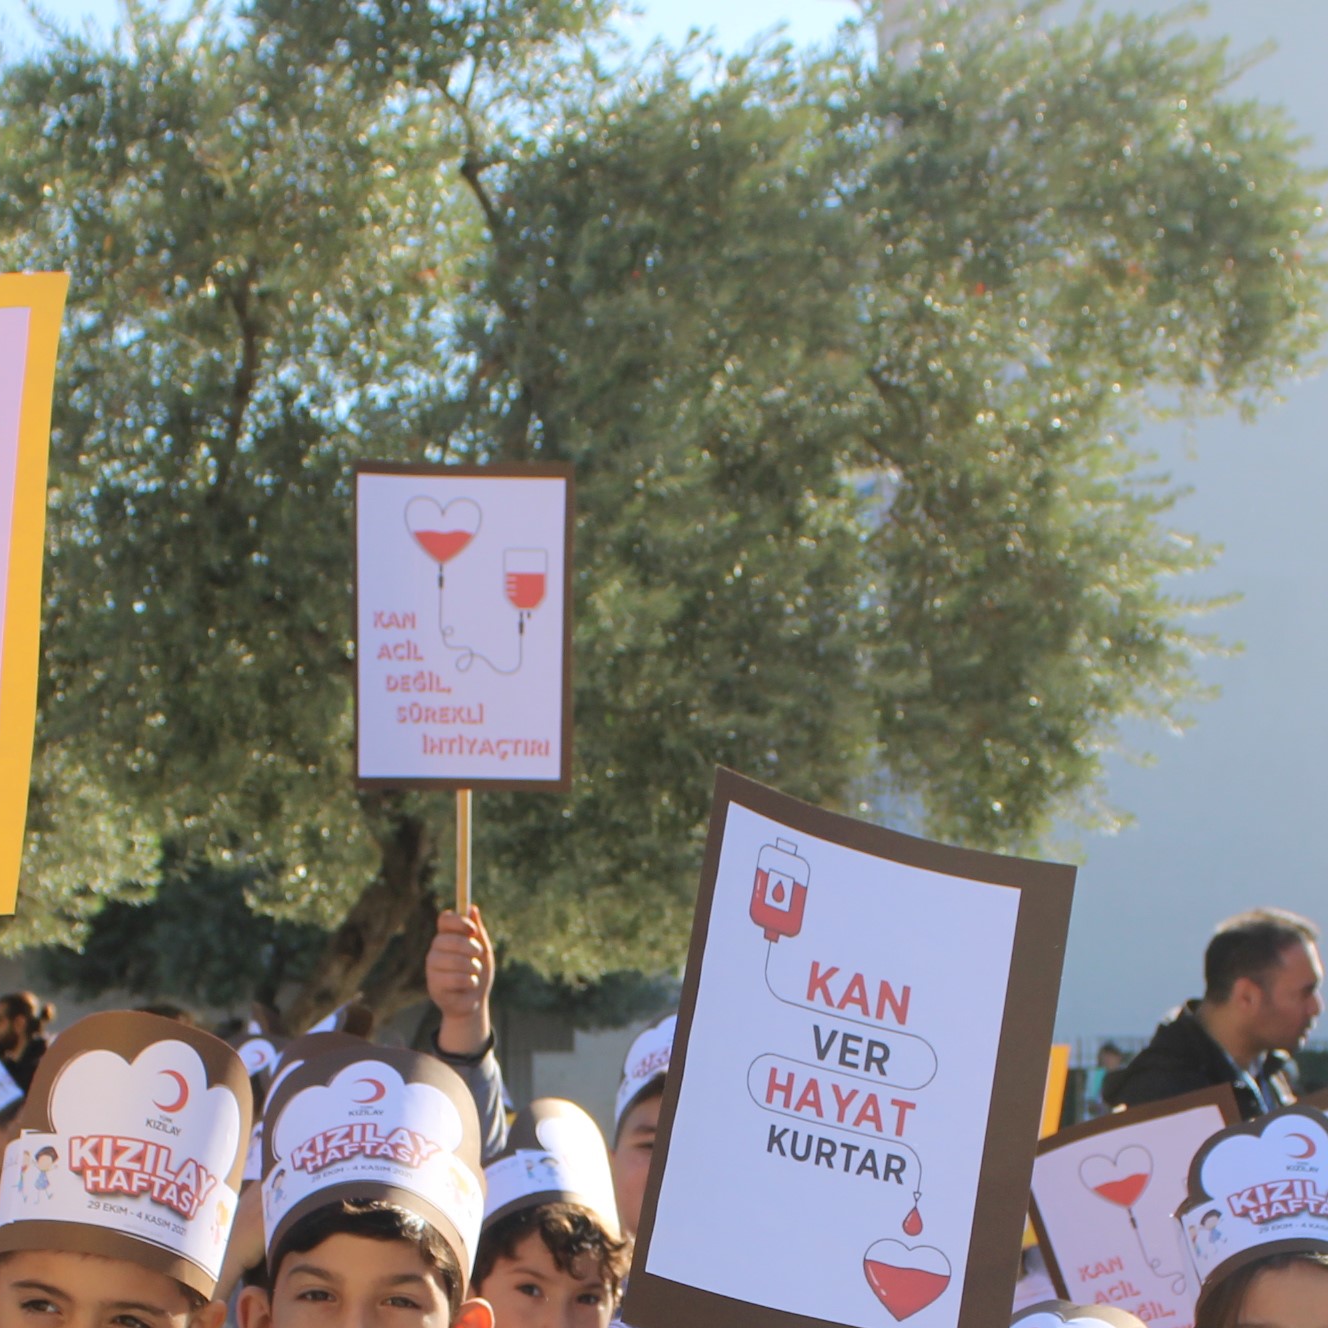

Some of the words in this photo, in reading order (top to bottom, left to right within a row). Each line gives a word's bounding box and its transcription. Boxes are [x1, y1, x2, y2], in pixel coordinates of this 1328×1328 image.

[373, 610, 416, 630] KAN
[377, 639, 424, 661] ACİL
[396, 703, 484, 725] SÜREKLİ
[806, 961, 911, 1026] KAN
[812, 1024, 891, 1077] VER
[764, 1067, 916, 1138] HAYAT
[145, 1118, 182, 1136] KIZILAY
[291, 1123, 442, 1170] KIZILAY
[70, 1135, 216, 1204] KIZILAY
[304, 1142, 421, 1174] HAFTASI
[766, 1124, 907, 1186] KURTAR
[85, 1168, 200, 1220] HAFTASI
[87, 1200, 100, 1210] 29
[136, 1210, 143, 1219] 4
[145, 1213, 171, 1230] KASIM
